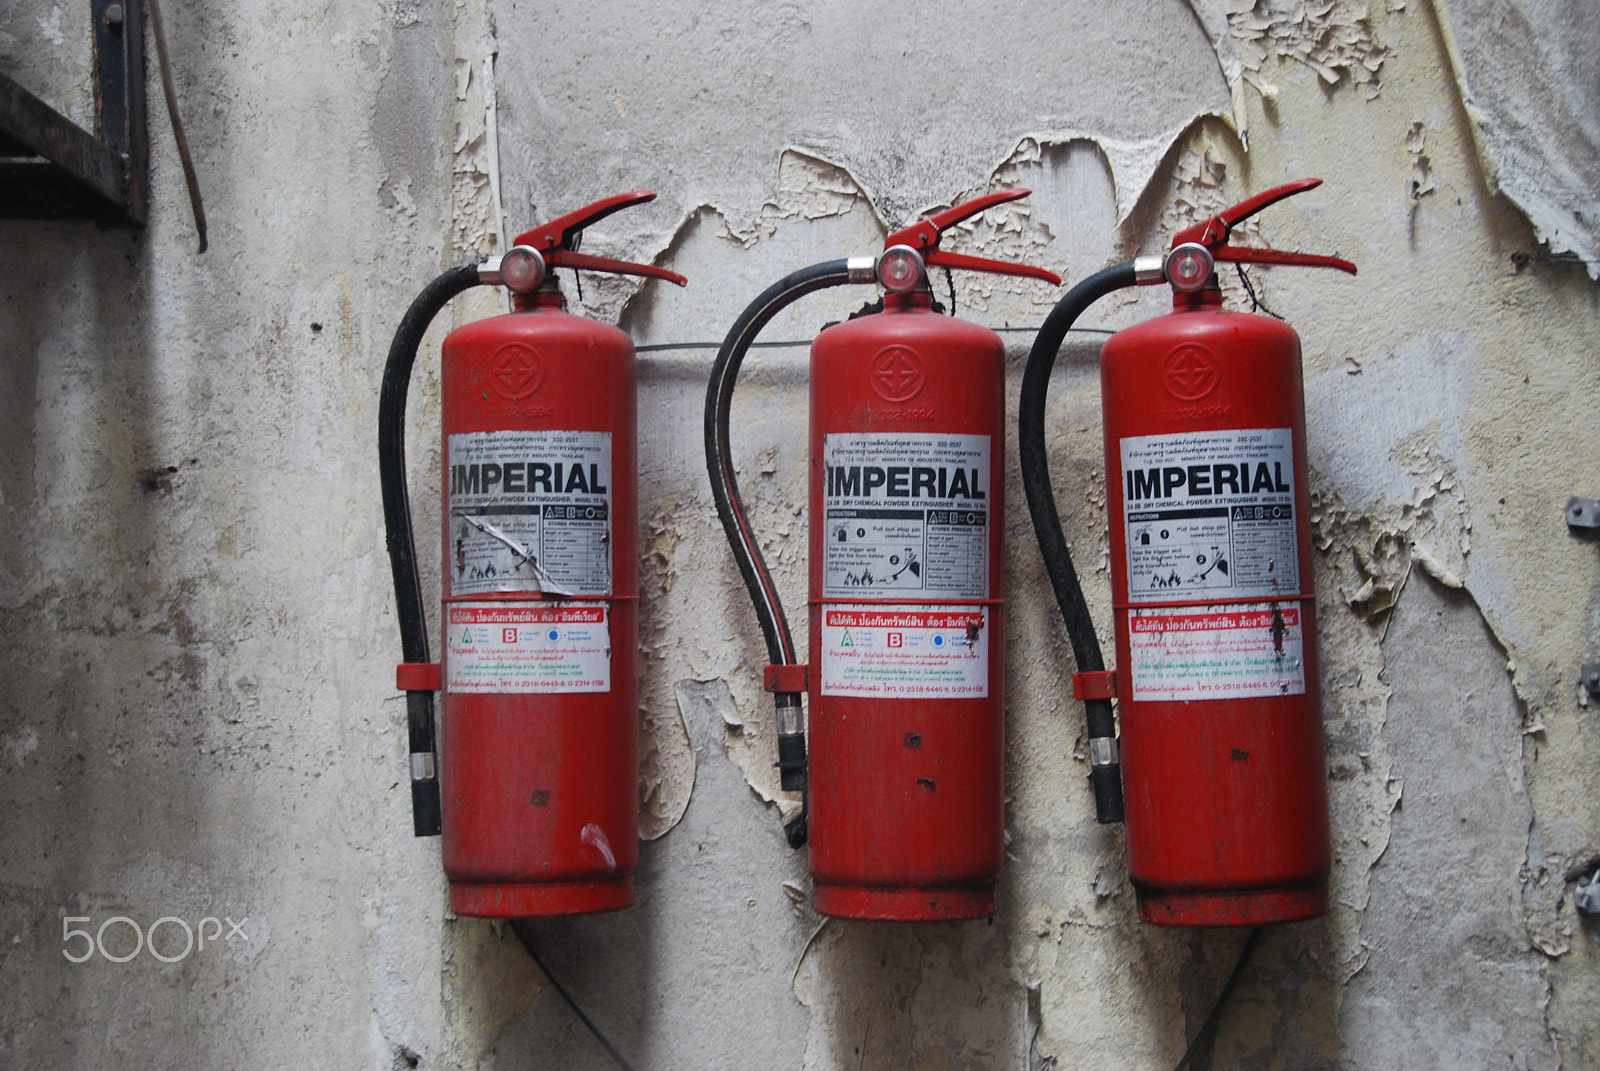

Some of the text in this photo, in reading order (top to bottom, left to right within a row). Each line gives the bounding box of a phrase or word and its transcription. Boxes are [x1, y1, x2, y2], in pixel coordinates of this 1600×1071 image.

[451, 462, 607, 495] IMPERIAL
[827, 466, 985, 499] IMPERIAL
[1126, 462, 1290, 500] IMPERIAL
[883, 500, 910, 508] POWDER
[1186, 498, 1213, 506] POWDER
[1214, 497, 1258, 505] EXTINGUISHER
[504, 629, 517, 643] B
[889, 633, 902, 647] B
